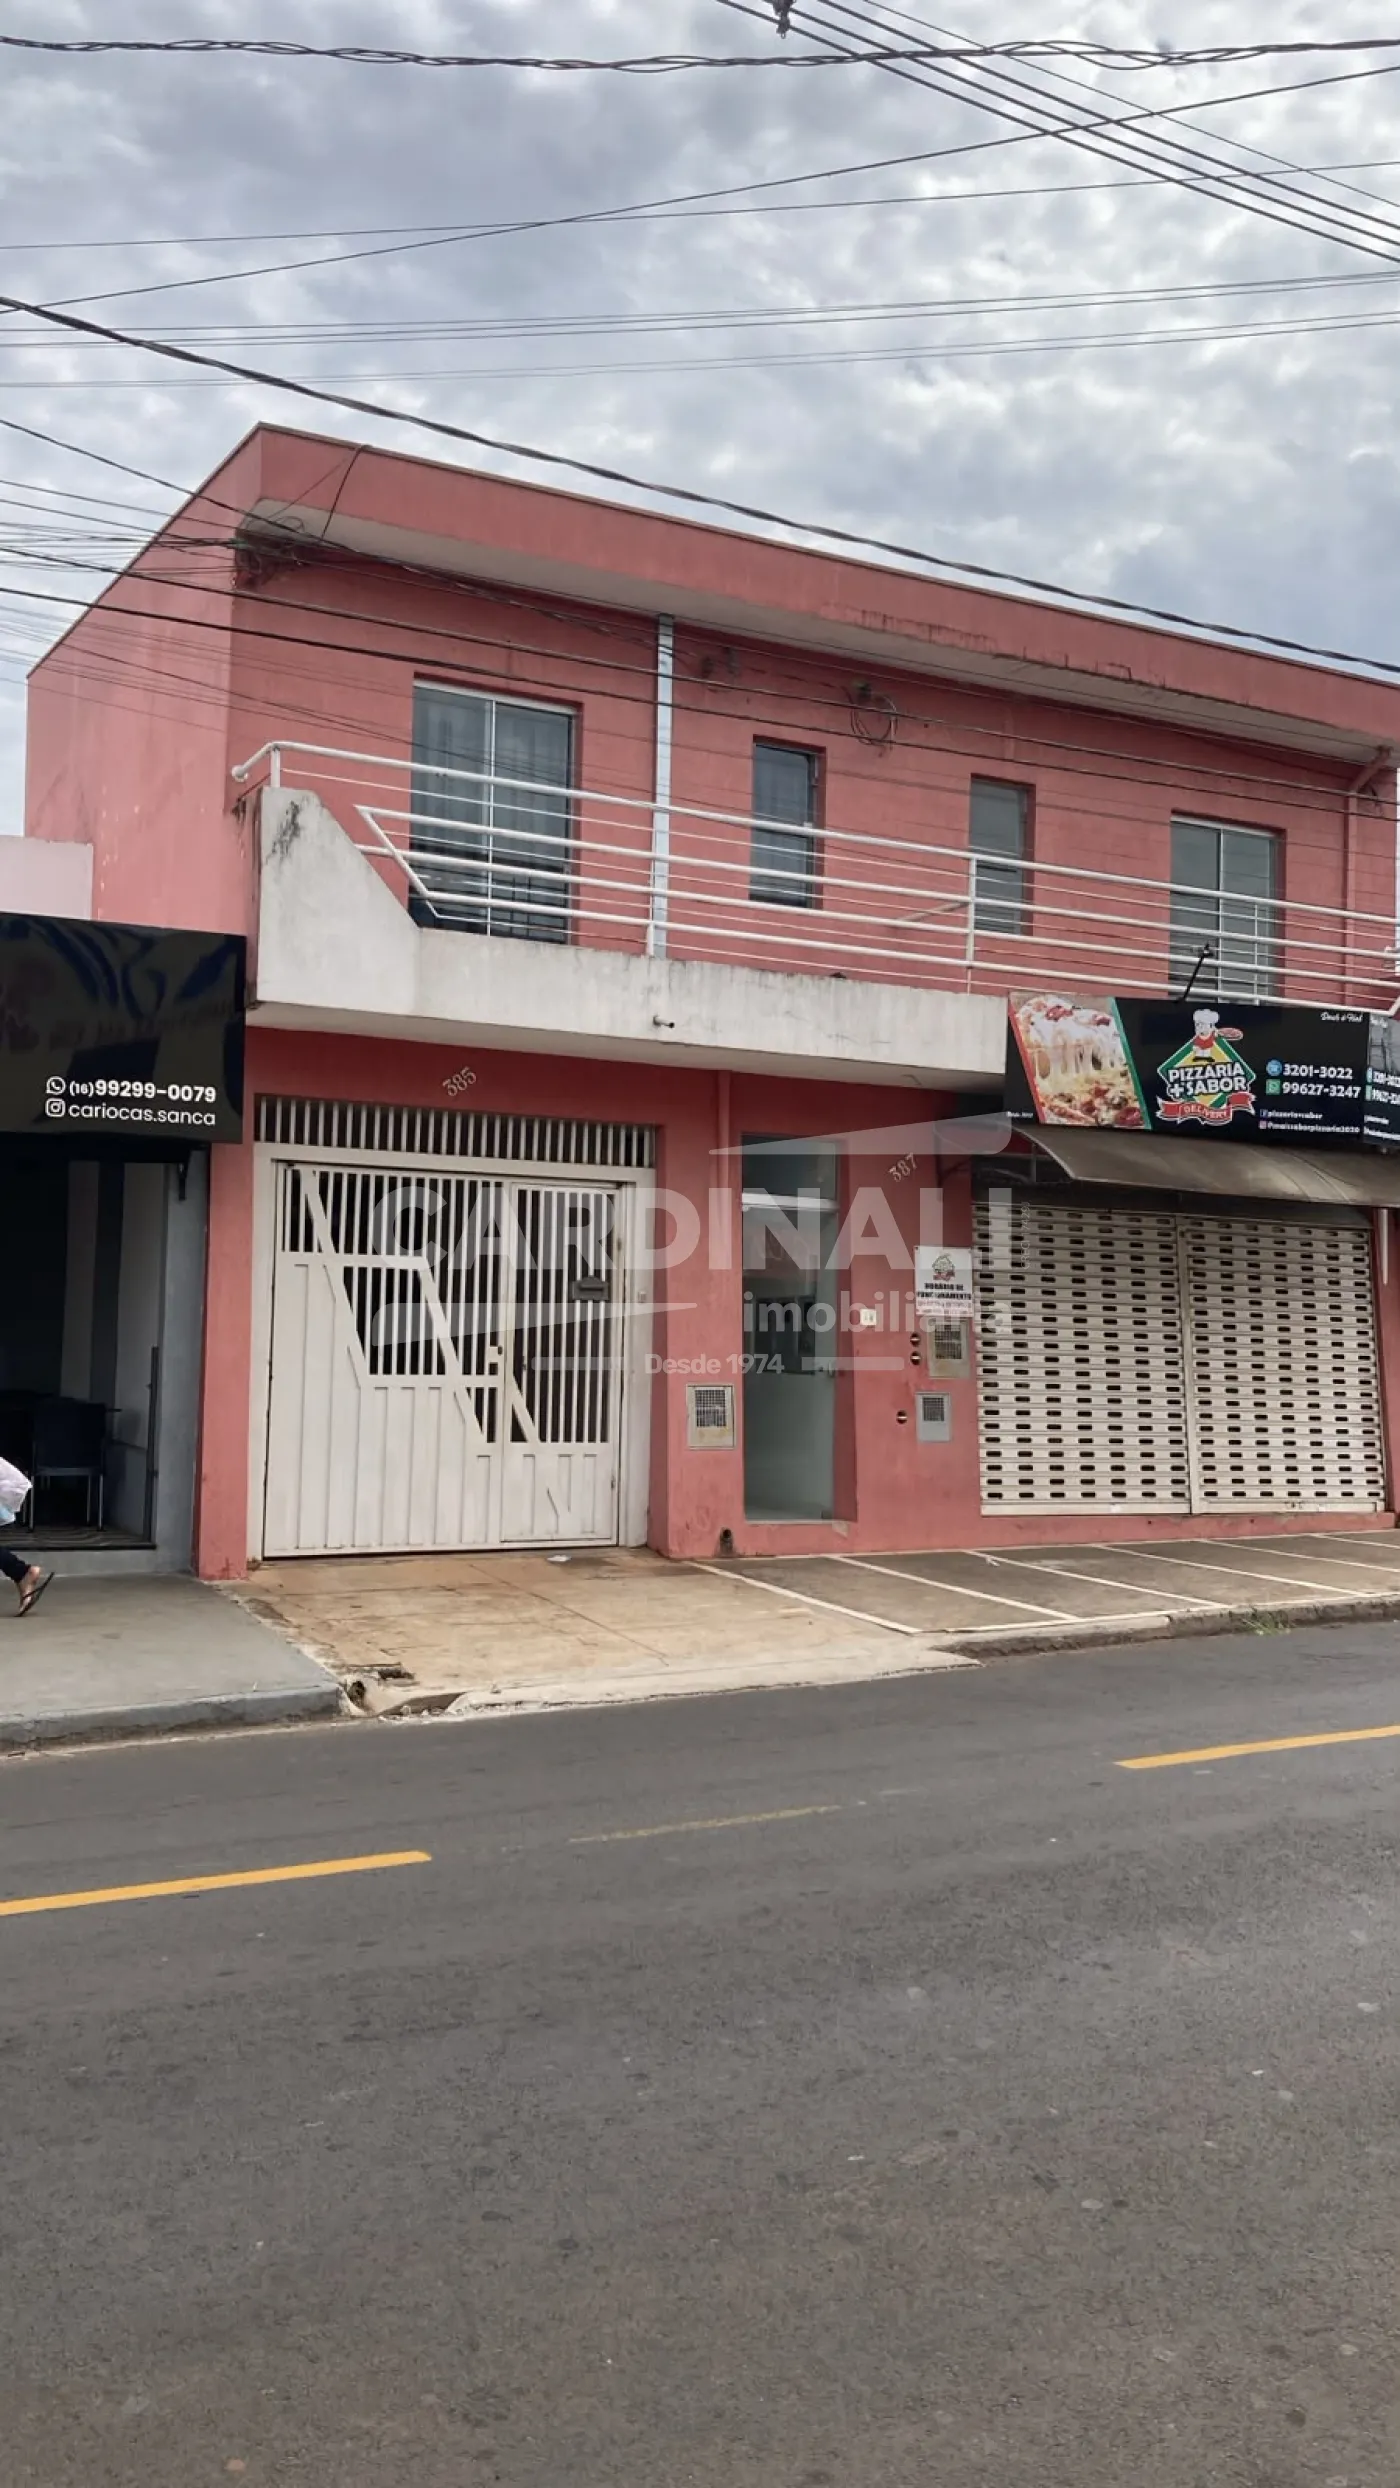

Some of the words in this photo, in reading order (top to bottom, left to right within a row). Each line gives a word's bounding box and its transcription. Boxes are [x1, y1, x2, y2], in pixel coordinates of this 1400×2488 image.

[442, 1066, 477, 1097] 385
[1168, 1062, 1245, 1082] PIZZARIA
[1282, 1063, 1353, 1080] 3201-3022
[69, 1079, 217, 1103] (16)99299-0079
[1282, 1081, 1361, 1099] 99627-3247
[68, 1102, 217, 1126] cariocas.sanca
[1183, 1105, 1228, 1120] DELIVERY
[889, 1152, 918, 1182] 387
